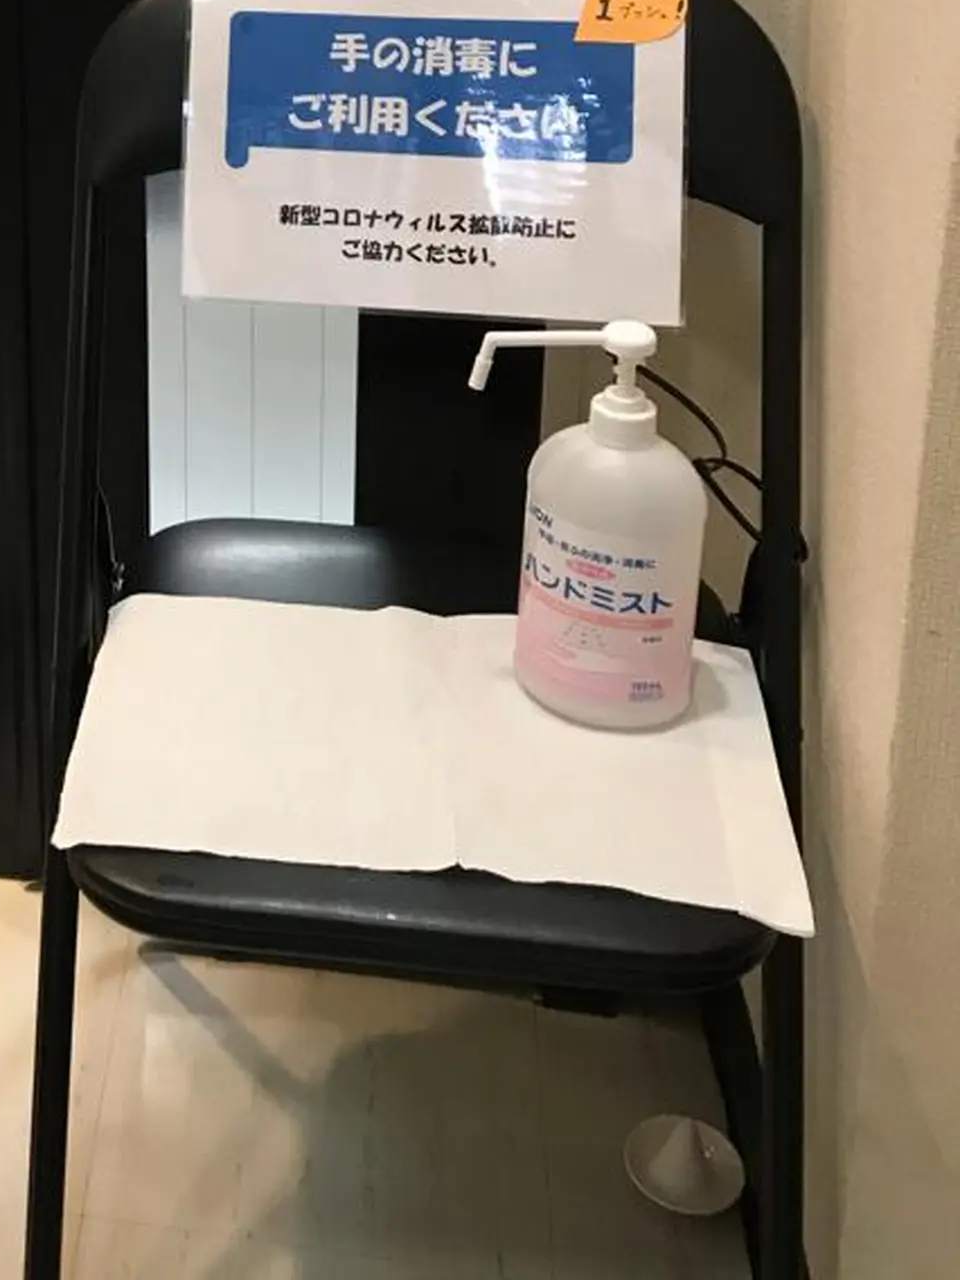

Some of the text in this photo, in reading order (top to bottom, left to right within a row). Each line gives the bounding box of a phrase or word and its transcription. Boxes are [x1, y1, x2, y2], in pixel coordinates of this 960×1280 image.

[328, 32, 538, 81] 手の消毒に
[340, 239, 499, 268] ご協力ください。
[524, 552, 673, 615] ハンドミスト
